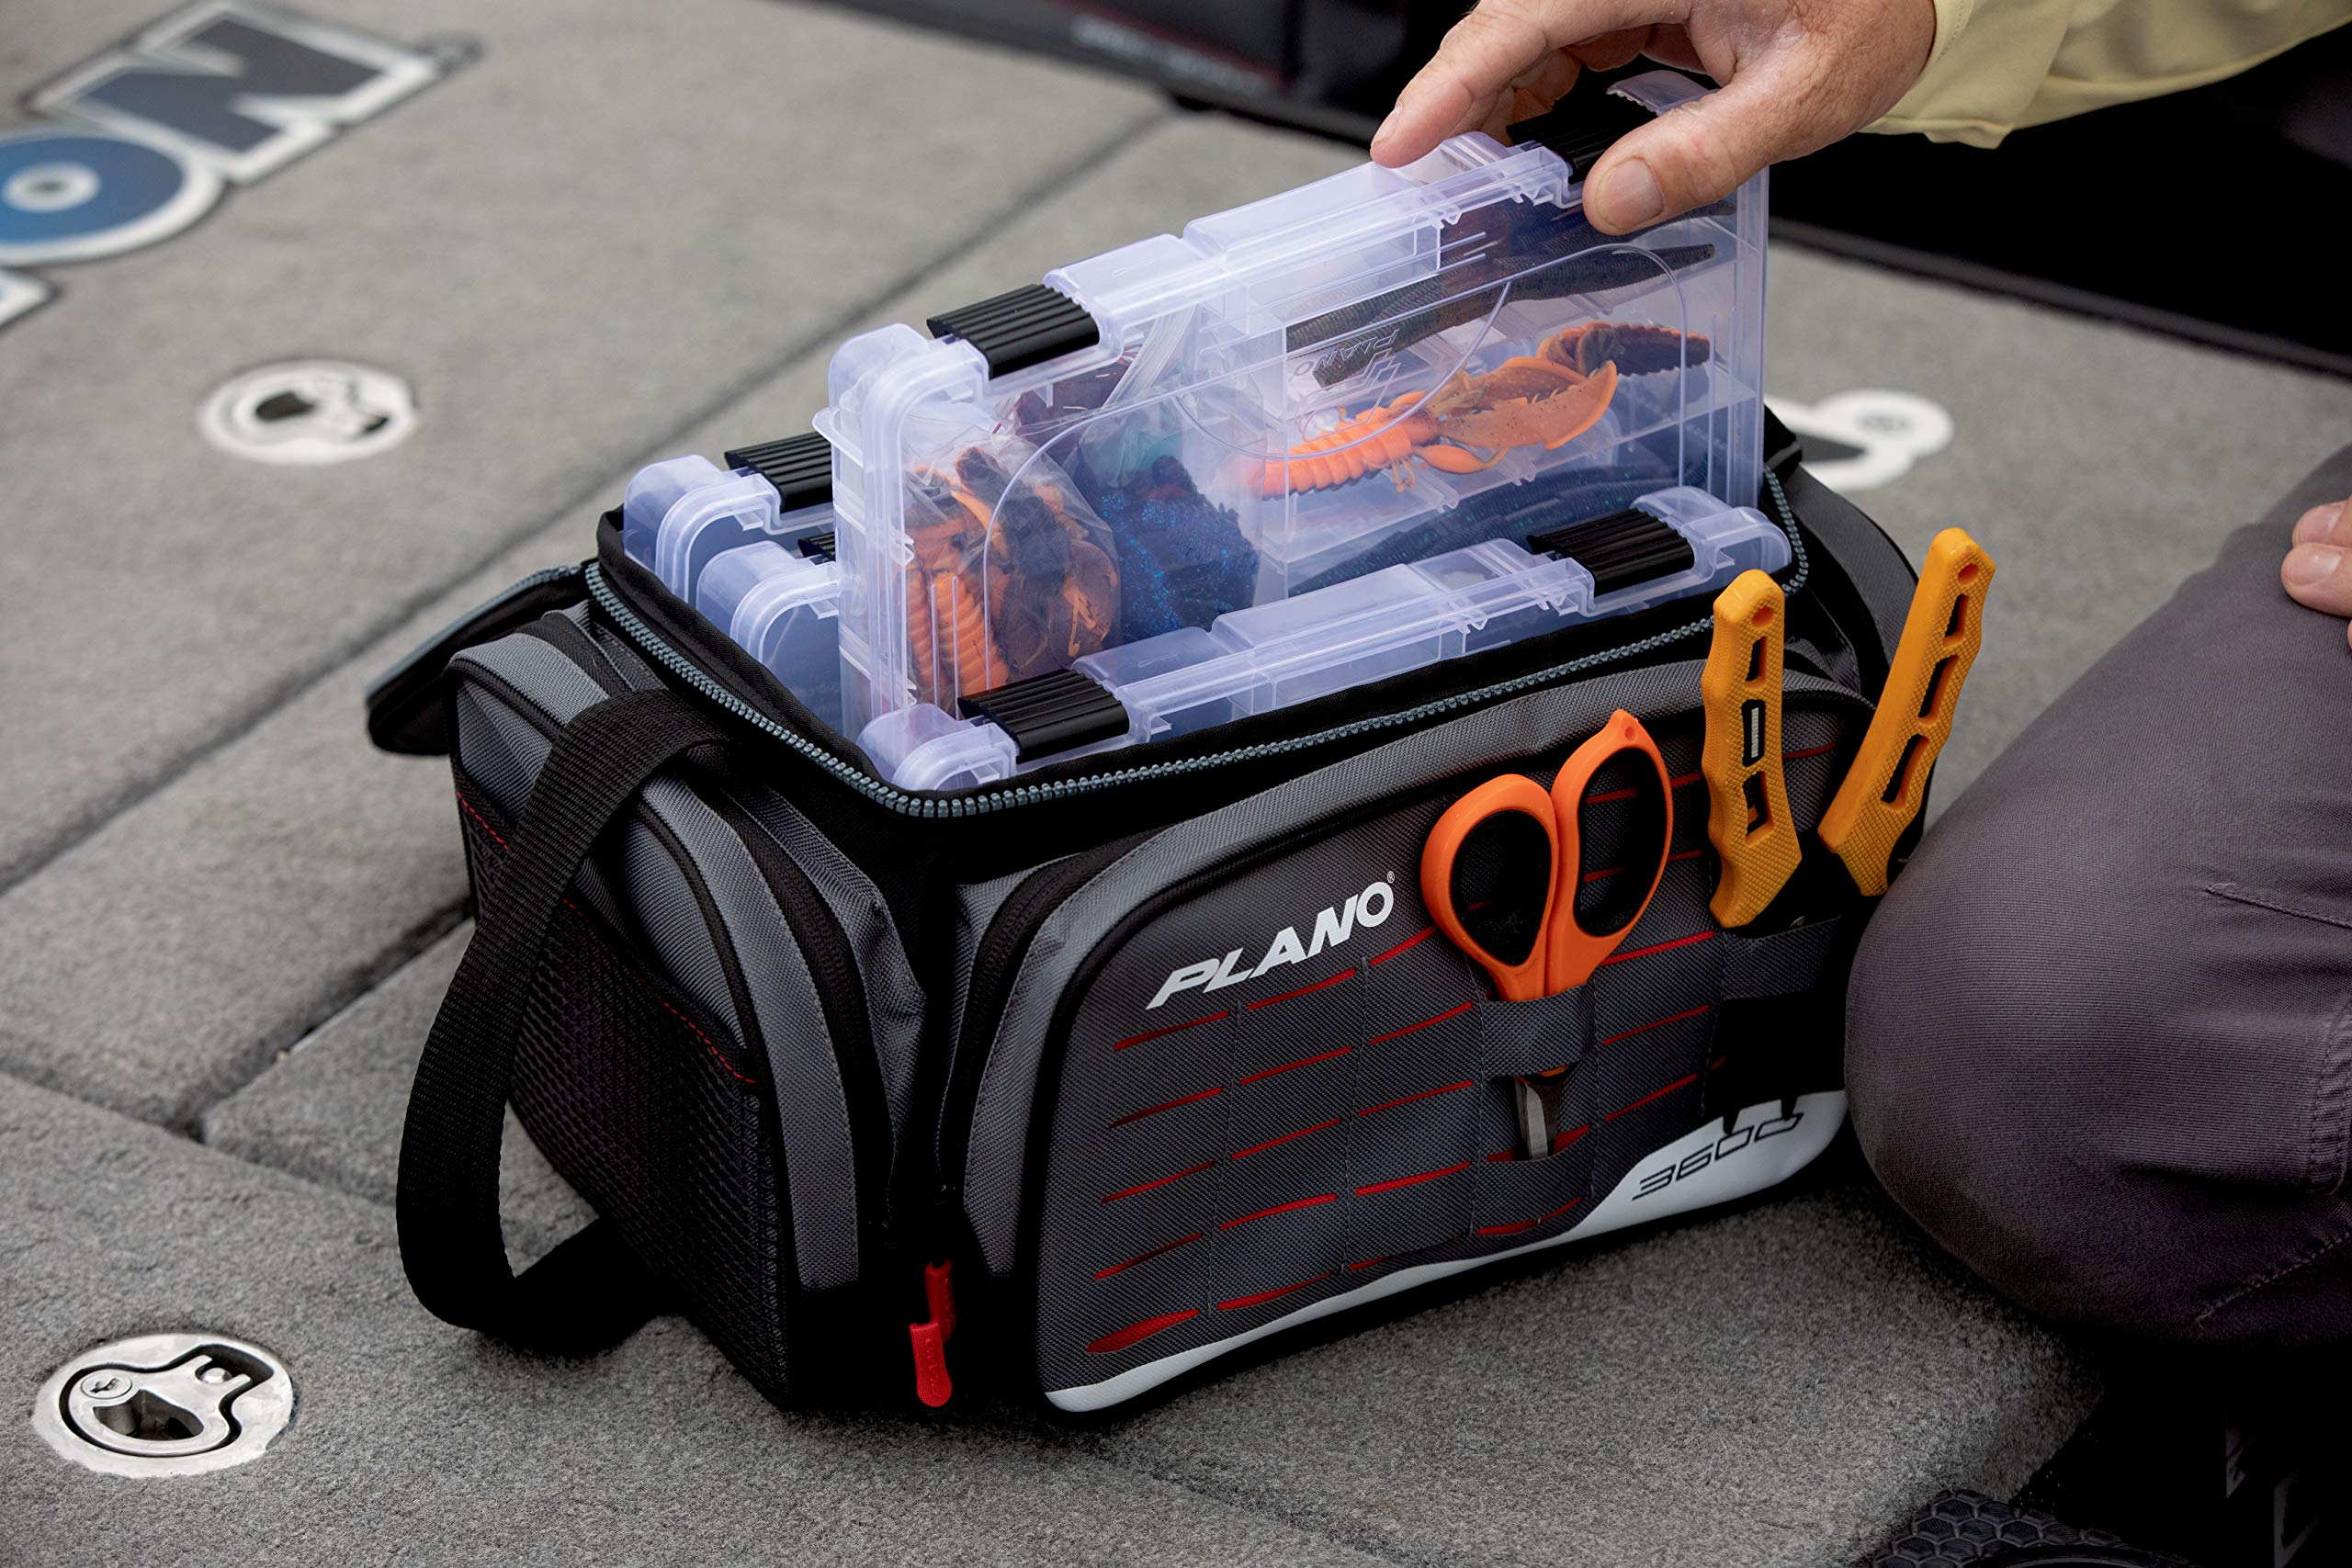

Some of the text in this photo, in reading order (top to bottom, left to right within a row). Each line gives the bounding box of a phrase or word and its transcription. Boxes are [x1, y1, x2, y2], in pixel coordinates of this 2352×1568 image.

[0, 0, 439, 327] ON
[1293, 329, 1399, 377] PLANO
[1631, 1112, 1804, 1201] 3600
[925, 1337, 942, 1397] PLANO
